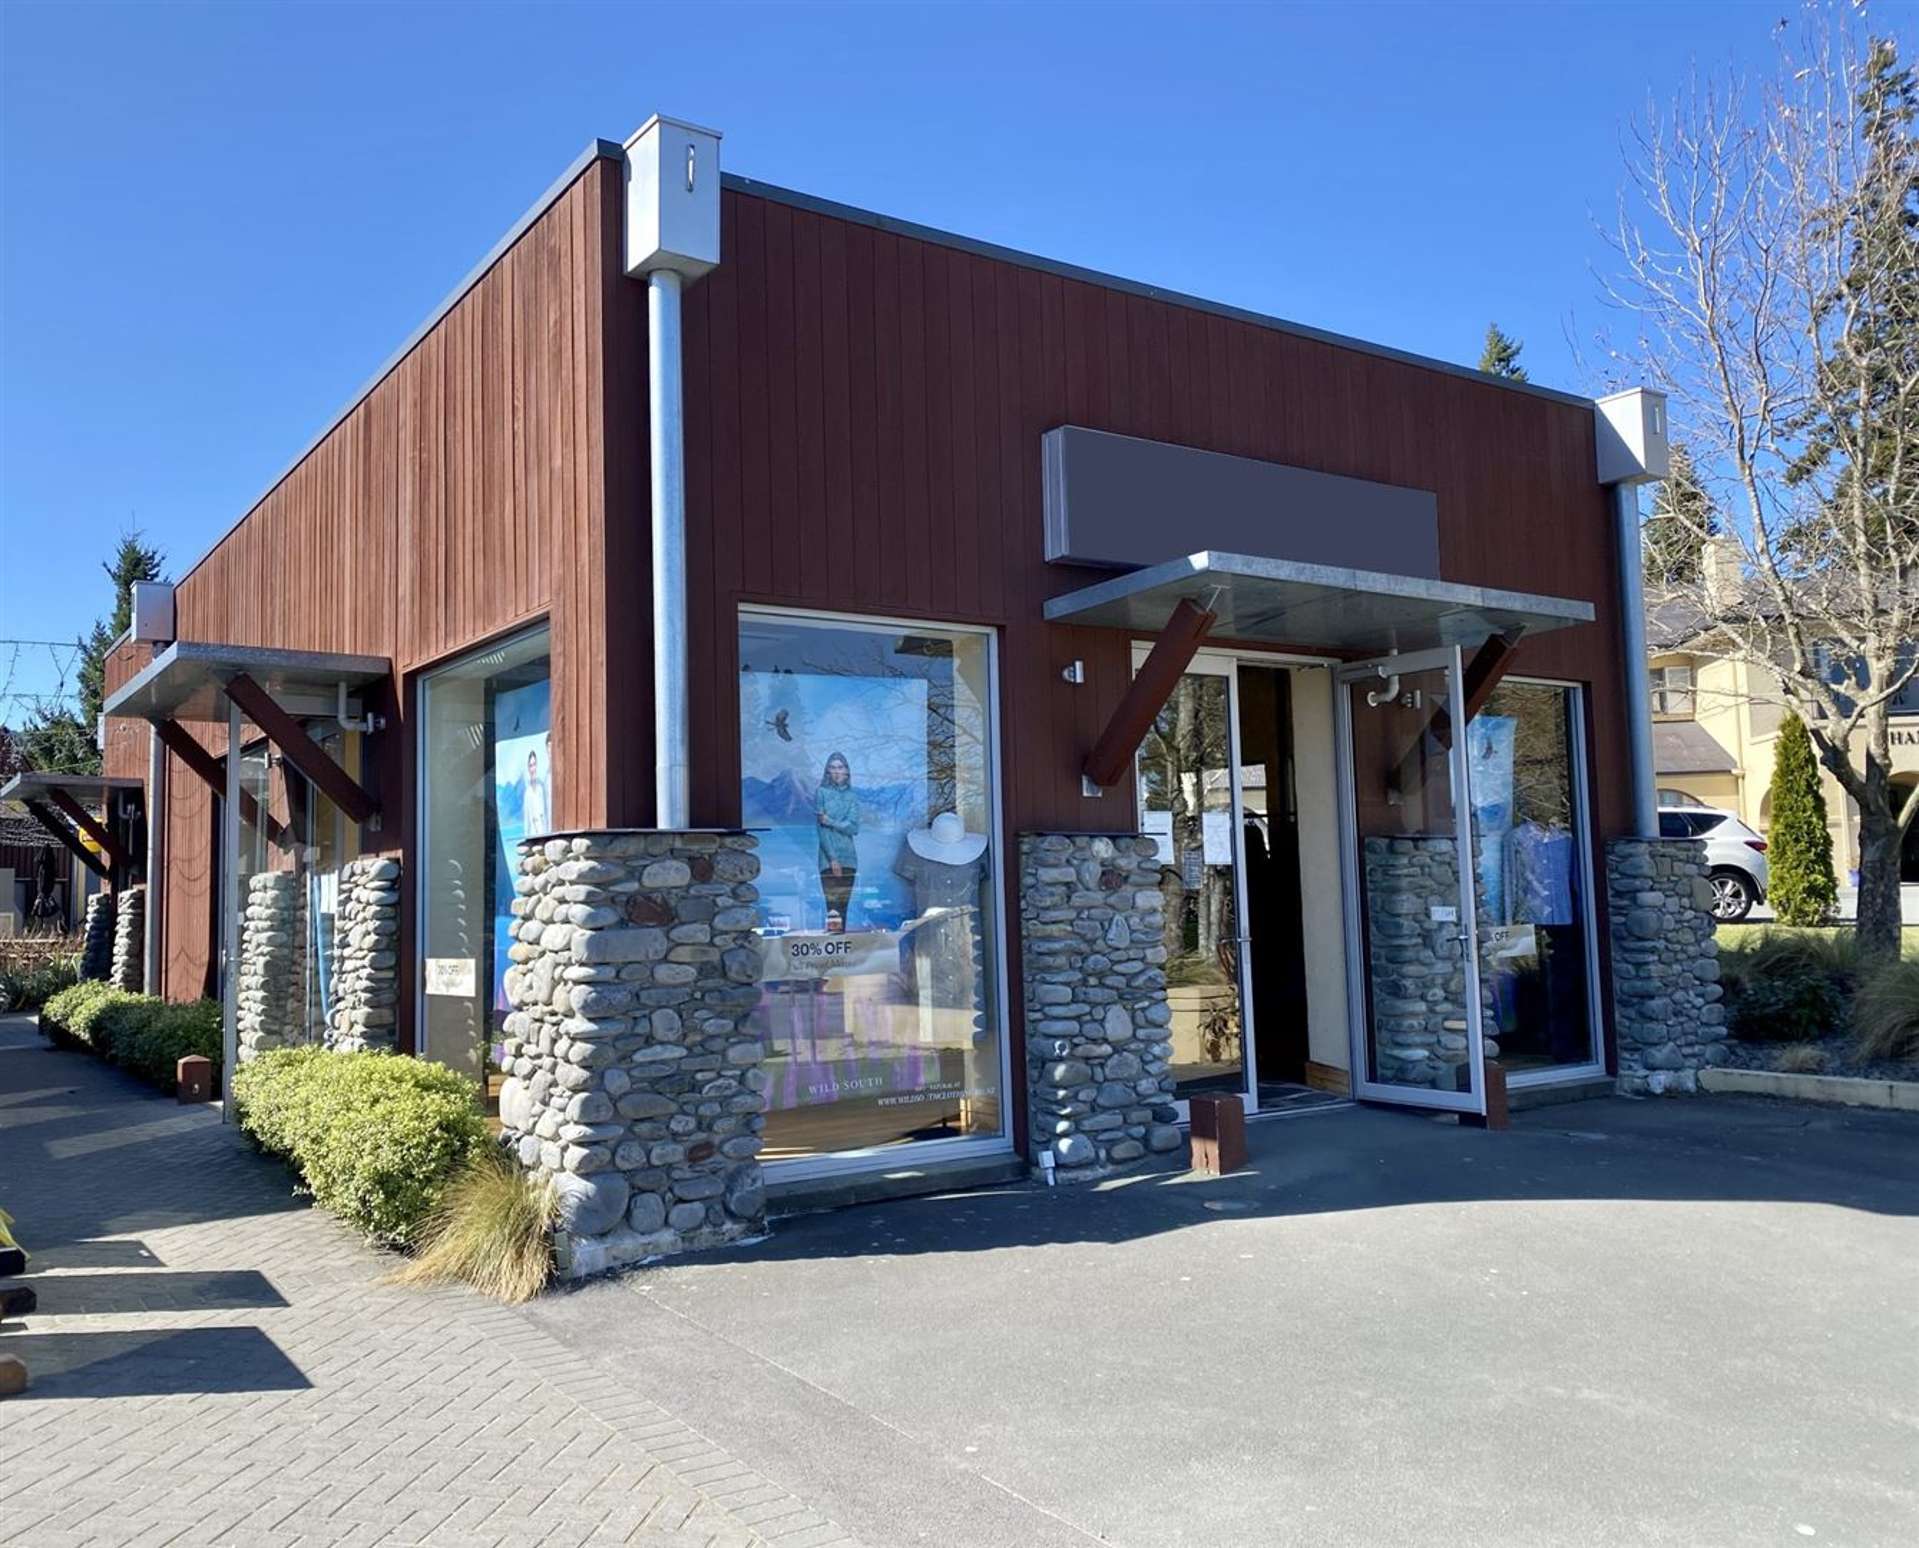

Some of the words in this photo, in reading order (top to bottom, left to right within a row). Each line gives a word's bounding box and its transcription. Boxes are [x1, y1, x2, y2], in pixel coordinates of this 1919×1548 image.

[1890, 731, 1919, 745] HA
[791, 943, 822, 957] 30%
[824, 941, 852, 954] OFF
[808, 1081, 839, 1094] WILD
[842, 1077, 882, 1090] SOUTH
